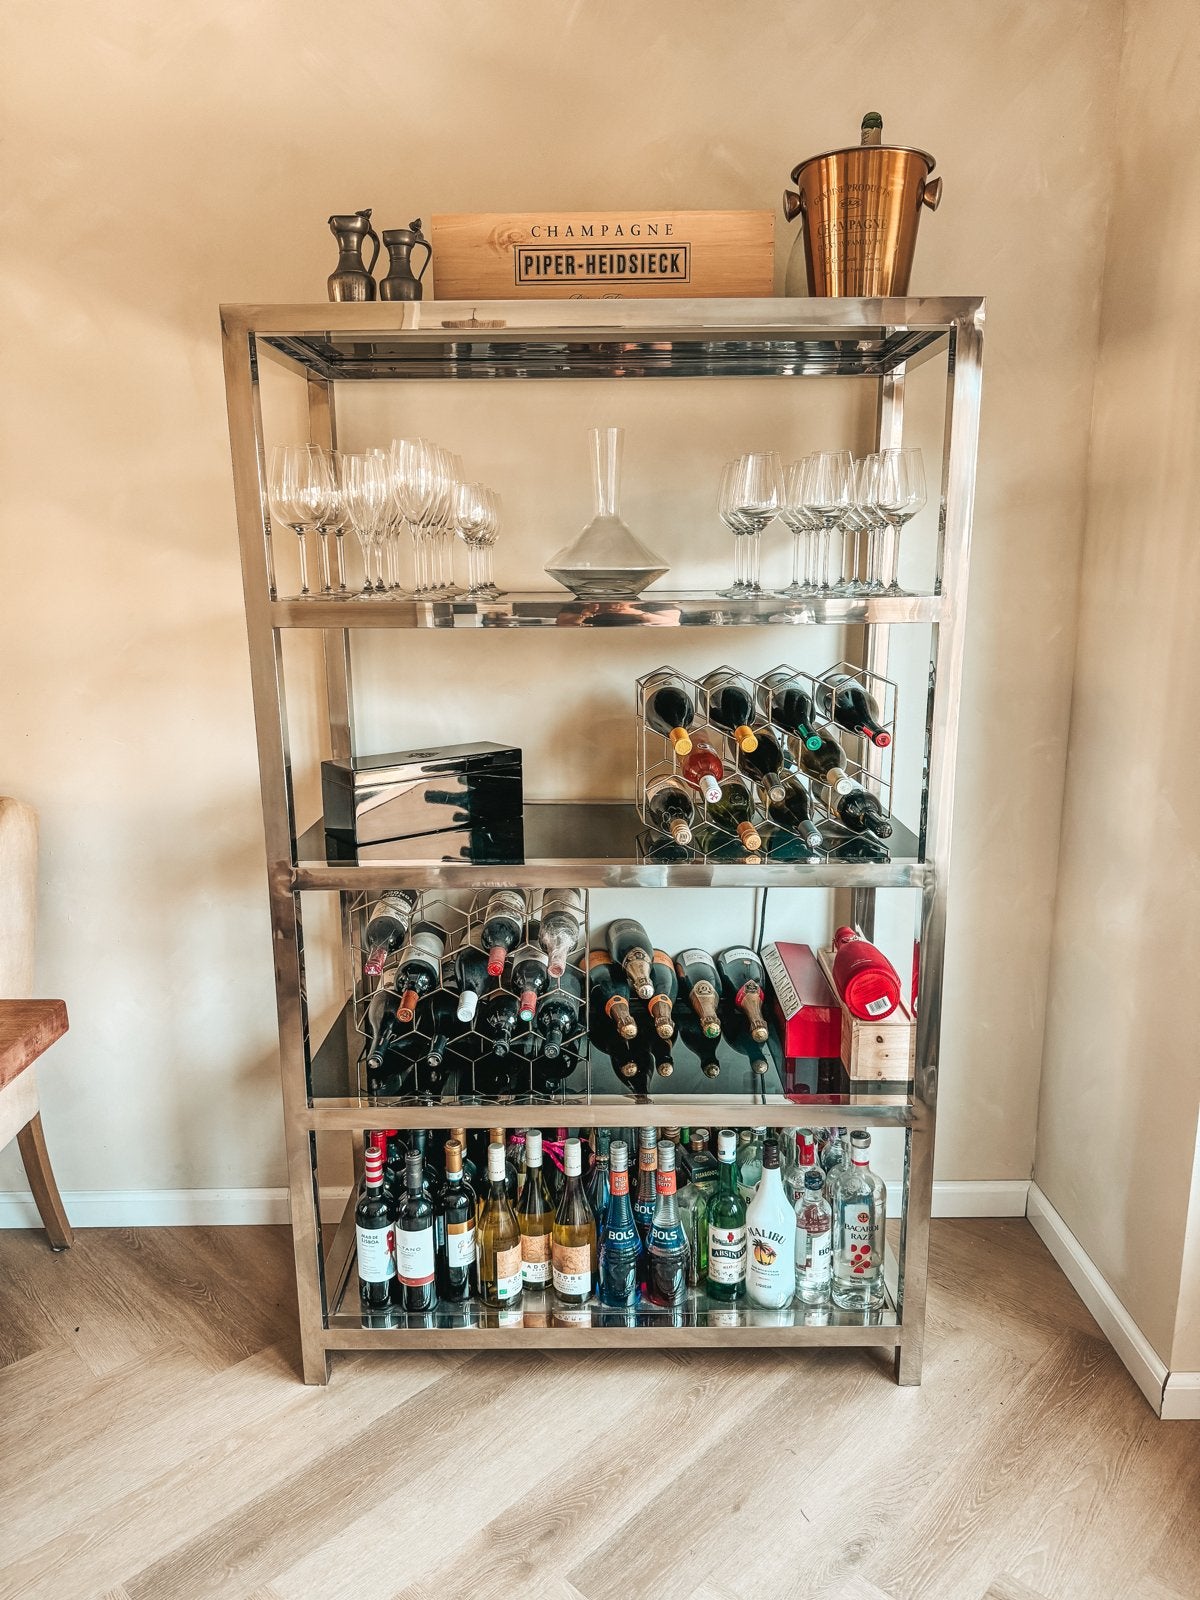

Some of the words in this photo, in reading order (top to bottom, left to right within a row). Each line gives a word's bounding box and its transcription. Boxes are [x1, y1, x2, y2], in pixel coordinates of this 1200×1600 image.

[847, 183, 891, 198] PRODUCTS
[531, 223, 674, 239] CHAMPAGNE
[817, 218, 888, 236] CHAMPAGNE
[524, 253, 681, 275] PIPER-HEIDSIECK
[608, 1228, 635, 1240] BOLS
[652, 1228, 678, 1241] BOLS
[844, 1223, 880, 1233] BACARDI
[747, 1227, 786, 1245] MALIBU
[850, 1232, 875, 1241] RAZZ
